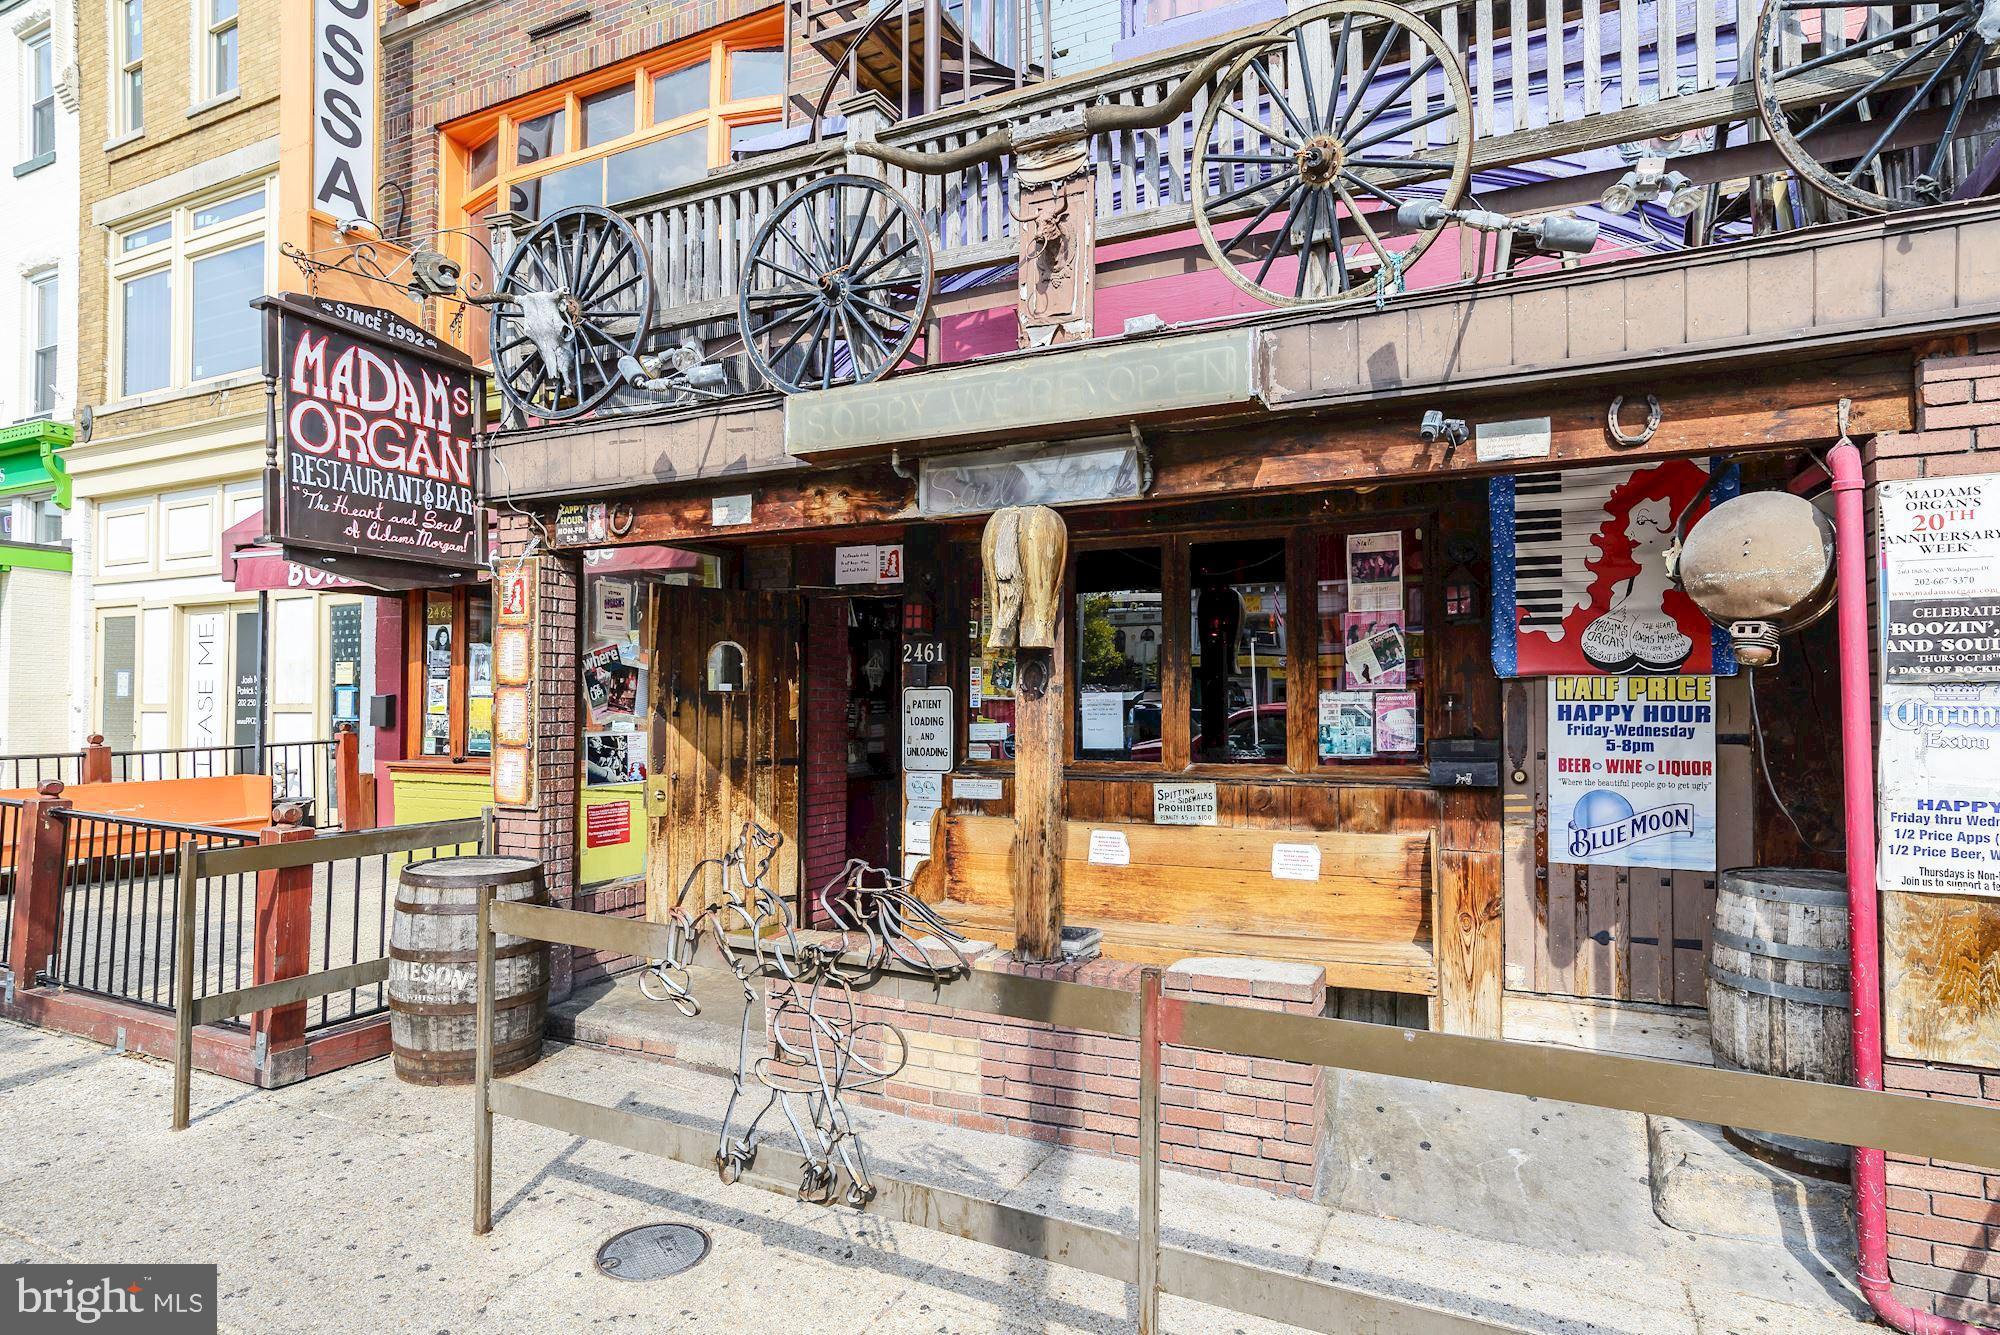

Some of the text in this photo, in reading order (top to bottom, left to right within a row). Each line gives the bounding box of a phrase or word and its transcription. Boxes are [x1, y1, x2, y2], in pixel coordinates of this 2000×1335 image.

[335, 304, 425, 347] SINCE 1992
[802, 393, 928, 442] SORRY
[1108, 348, 1233, 400] OPEN
[290, 400, 471, 486] ORGAN
[291, 453, 423, 505] RESTAURANT
[435, 483, 473, 515] BAR
[1905, 486, 1981, 500] MADAMS
[1905, 498, 1981, 511] ORGAN'S
[332, 495, 384, 522] Heart
[389, 511, 418, 527] and
[423, 510, 462, 534] Soul
[561, 516, 583, 525] HOUR
[1912, 509, 1975, 531] 20TH
[344, 519, 360, 541] of
[367, 521, 414, 546] Adams
[1920, 543, 1968, 554] WEEK
[1914, 576, 1975, 586] 202-667-5370
[1912, 605, 2000, 618] CELEBRATE
[1587, 631, 1625, 649] ORGAN
[1886, 640, 1934, 653] AND
[583, 648, 619, 671] where
[903, 642, 943, 662] 2461
[1918, 654, 1955, 662] THURS
[1956, 653, 1980, 662] OCT
[1888, 666, 1897, 675] 4
[1899, 666, 1931, 675] DAYS
[1934, 665, 1952, 674] OF
[590, 690, 604, 701] UP!
[1555, 677, 1711, 702] HALF PRICE
[912, 699, 942, 709] PATIENT
[910, 716, 944, 726] LOADING
[1557, 704, 1711, 723] HAPPY HOUR
[1888, 698, 2000, 735] Coron
[920, 732, 934, 741] AND
[1567, 723, 1696, 739] Friday-Wednesday
[1606, 739, 1655, 754] 5-8pm
[1925, 729, 1990, 750] Extra
[906, 747, 948, 757] UNLOADING
[1558, 757, 1712, 777] BEER WINE LIQUOR
[1584, 778, 1596, 787] the
[1597, 778, 1630, 788] beautiful
[1631, 780, 1655, 790] people
[1657, 783, 1667, 791] go
[1668, 781, 1676, 789] to
[1677, 781, 1690, 791] get
[1157, 788, 1195, 801] SPITTING
[1178, 792, 1213, 804] SIDEWALKS
[1158, 803, 1213, 812] PROHIBITED
[1890, 812, 1931, 826] Friday
[1935, 814, 1962, 825] thru
[1570, 808, 1689, 857] BLUE MOON
[1894, 828, 1915, 840] 1/2
[1919, 829, 1953, 842] Price
[1957, 831, 1991, 845] Apps
[1888, 844, 1909, 856] 1/2
[1913, 845, 1947, 858] Price
[1951, 847, 1985, 862] Beer,
[1919, 866, 1965, 880] Thursdays
[1967, 868, 1975, 880] is
[1901, 875, 1920, 886] Join
[1922, 878, 1933, 887] us
[1935, 877, 1944, 887] to
[1984, 882, 1990, 891] a
